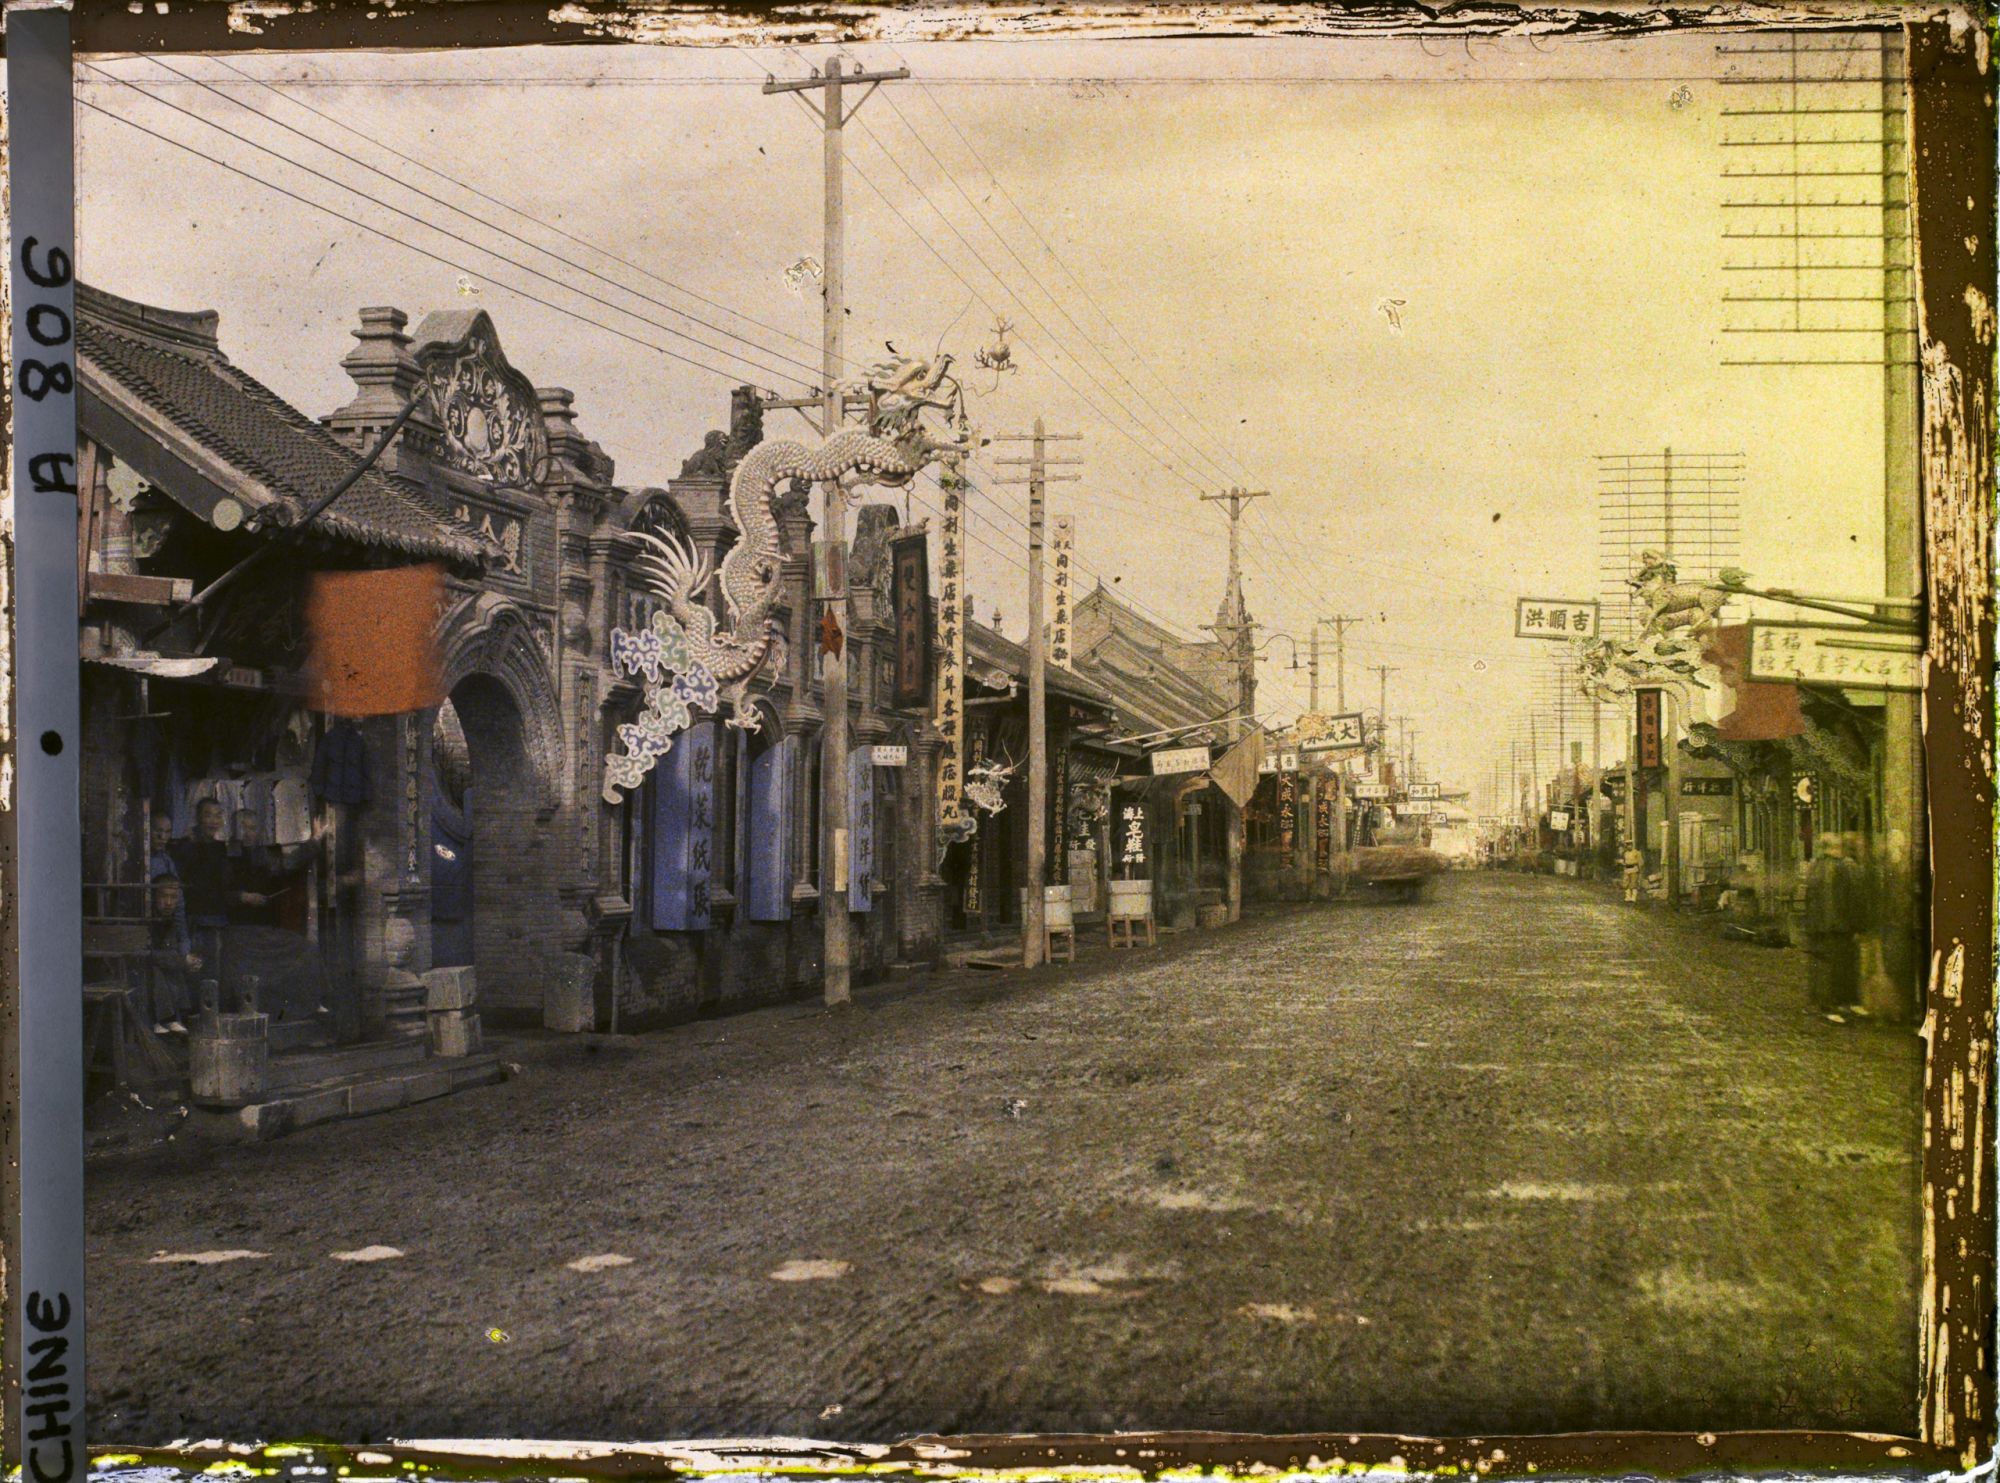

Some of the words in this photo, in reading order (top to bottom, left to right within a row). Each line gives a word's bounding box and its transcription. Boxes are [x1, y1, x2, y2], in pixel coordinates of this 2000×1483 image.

[18, 235, 74, 402] 806
[1526, 608, 1590, 632] 吉順洪
[25, 1290, 74, 1483] CHINE
